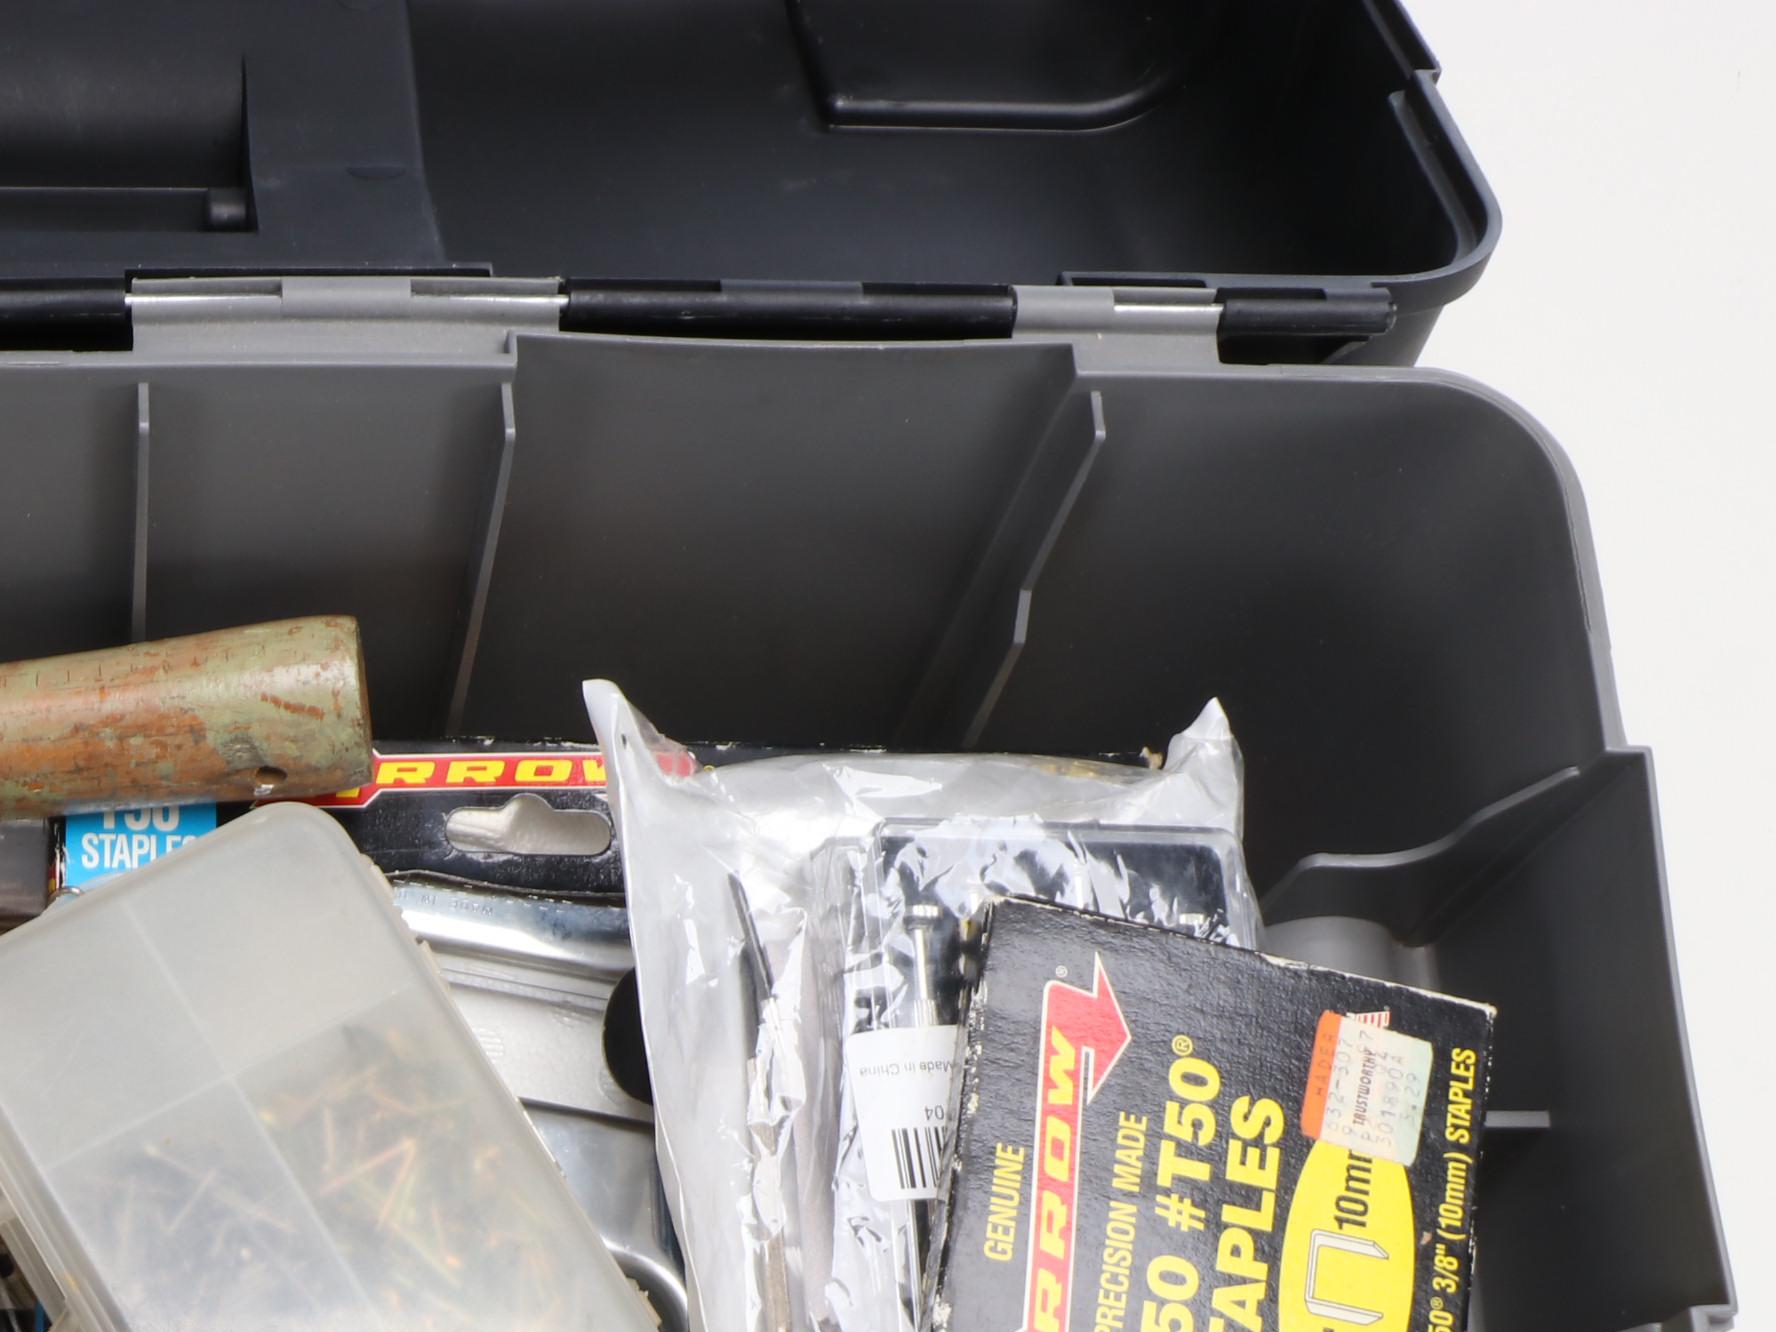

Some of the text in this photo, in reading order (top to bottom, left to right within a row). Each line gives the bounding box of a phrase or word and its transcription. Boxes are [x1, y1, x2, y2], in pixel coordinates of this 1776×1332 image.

[336, 760, 607, 798] RRO
[1352, 1045, 1375, 1127] TRUSTWORTHY
[1445, 1047, 1477, 1145] STAPLES
[1112, 1111, 1148, 1193] MADE
[984, 1142, 1024, 1261] GENUINE
[1436, 1152, 1473, 1241] (10mm)
[1432, 1243, 1460, 1294] 3/8"
